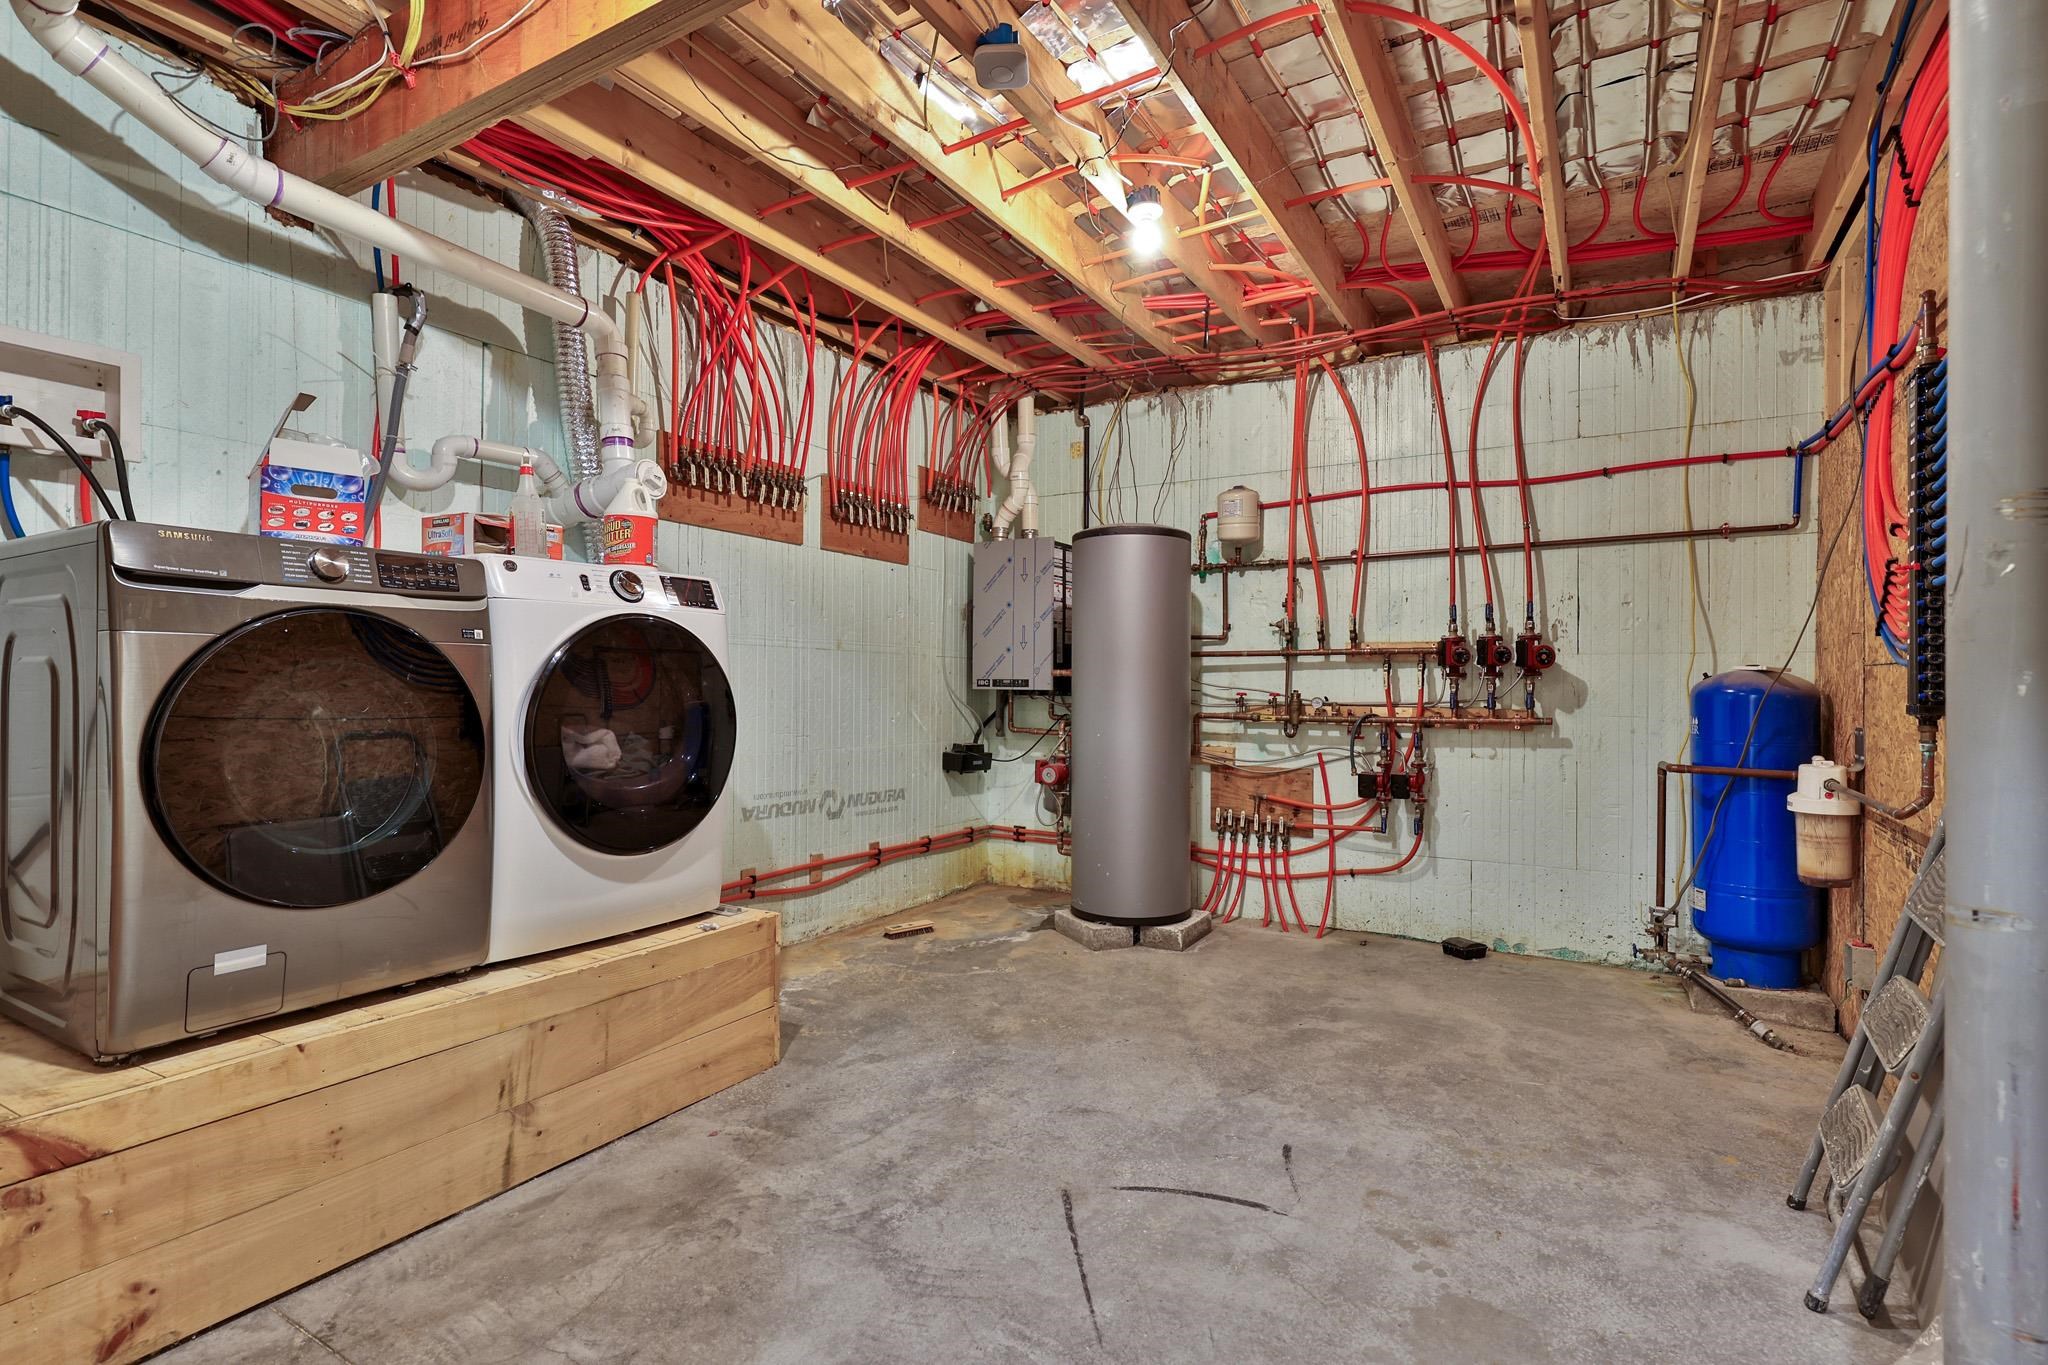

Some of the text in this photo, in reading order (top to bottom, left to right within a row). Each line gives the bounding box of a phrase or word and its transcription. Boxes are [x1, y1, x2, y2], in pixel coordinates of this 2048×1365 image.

[288, 499, 339, 509] MULTIPURPOSE
[158, 529, 213, 542] SAMSUNG
[604, 528, 632, 544] UTTER
[848, 788, 906, 808] NUDURA
[742, 798, 817, 822] NUDURA
